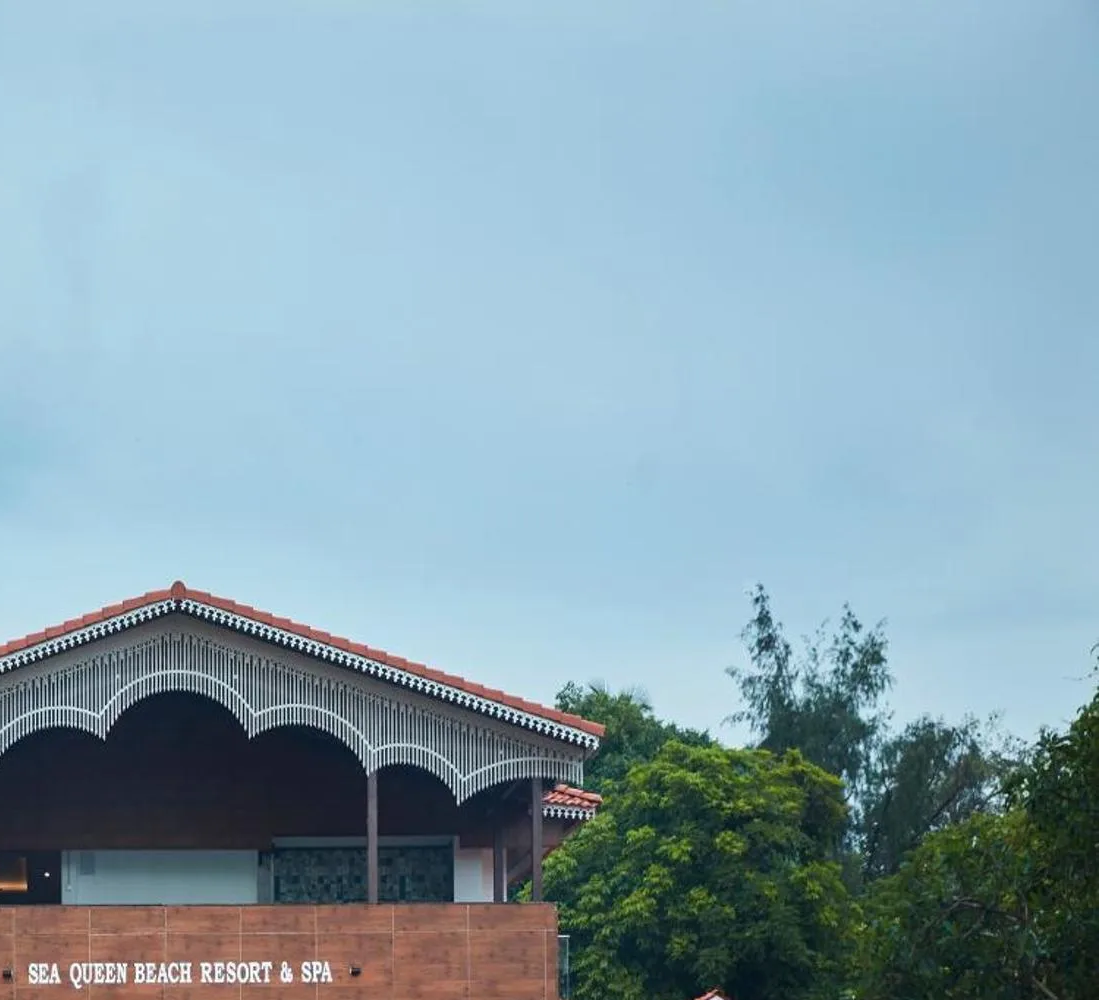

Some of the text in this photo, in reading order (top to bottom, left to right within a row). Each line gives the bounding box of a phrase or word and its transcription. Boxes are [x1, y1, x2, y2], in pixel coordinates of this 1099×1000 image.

[28, 961, 333, 989] SEA QUEEN BEACH RESORT & SPA
